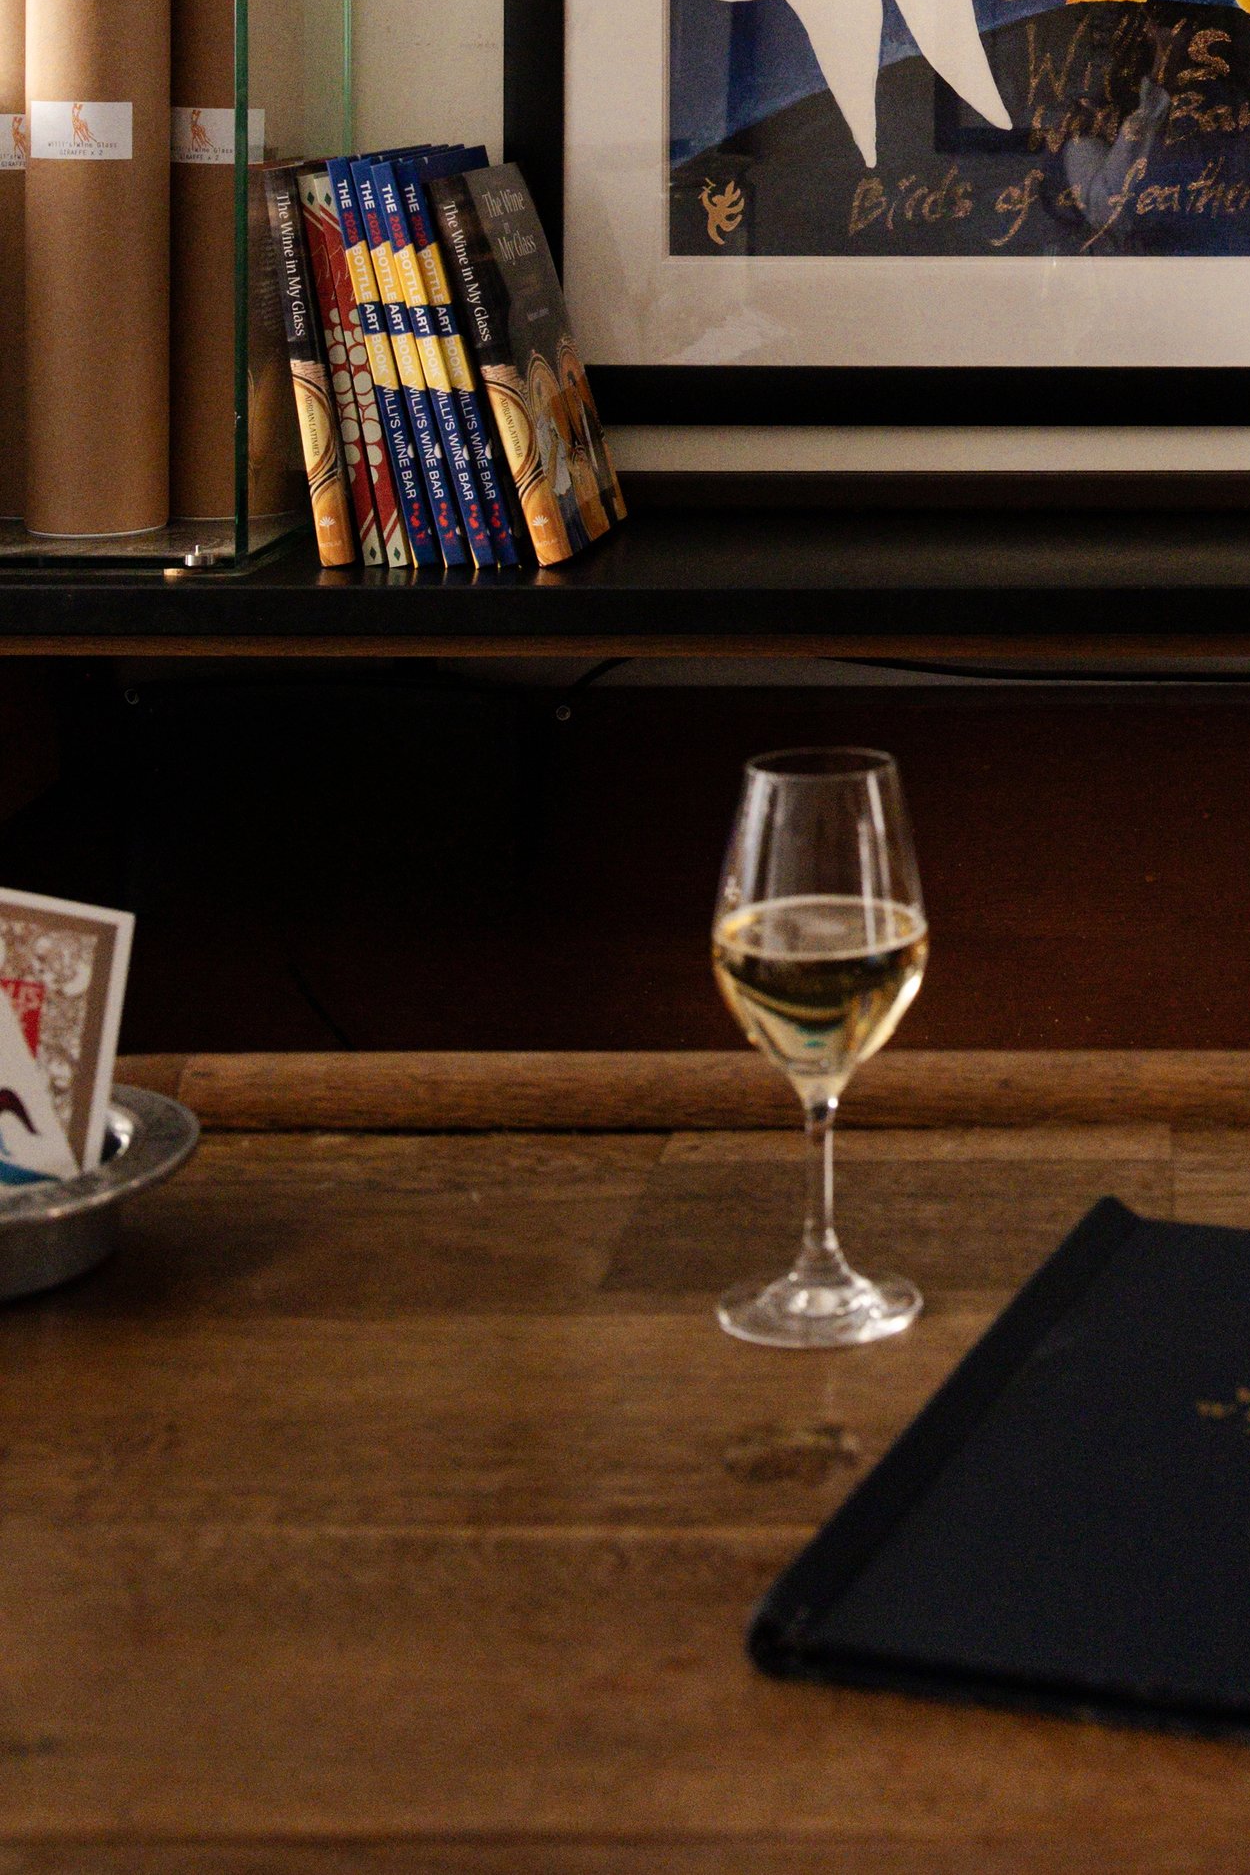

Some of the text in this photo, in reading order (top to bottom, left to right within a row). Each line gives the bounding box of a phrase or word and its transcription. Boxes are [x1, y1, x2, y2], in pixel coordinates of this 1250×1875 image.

[337, 180, 352, 210] THE
[404, 184, 419, 213] THE
[482, 189, 526, 218] The Wine
[849, 165, 973, 236] Birds
[990, 169, 1045, 247] of
[1056, 182, 1086, 210] a
[276, 191, 306, 337] The Wine in My Glass
[498, 230, 537, 266] My Glass
[351, 245, 372, 301] BOTTLE
[421, 248, 444, 305] BOTTLE
[443, 200, 492, 342] The Wine in My Glass
[364, 304, 380, 332] ART
[437, 307, 452, 334] ART
[360, 180, 375, 210] THE
[375, 245, 397, 301] BOTTLE
[389, 304, 405, 332] ART
[398, 334, 415, 375] BOOK
[409, 381, 427, 429] WILLI'S
[420, 431, 437, 467] WINE
[429, 471, 444, 500] BAR
[371, 334, 388, 375] BOOK
[382, 184, 397, 214] THE
[399, 250, 421, 308] BOTTLE
[414, 308, 430, 335] ART
[422, 338, 439, 378] BOOK
[437, 384, 456, 431] WILLI'S
[449, 433, 466, 469] WINE
[459, 473, 474, 502] BAR
[444, 338, 463, 378] BOOK
[383, 381, 400, 429] WILLI'S
[458, 383, 478, 430] WILLI'S
[393, 431, 410, 467] WINE
[470, 432, 488, 468] WINE
[402, 471, 417, 499] BAR
[480, 472, 496, 500] BAR
